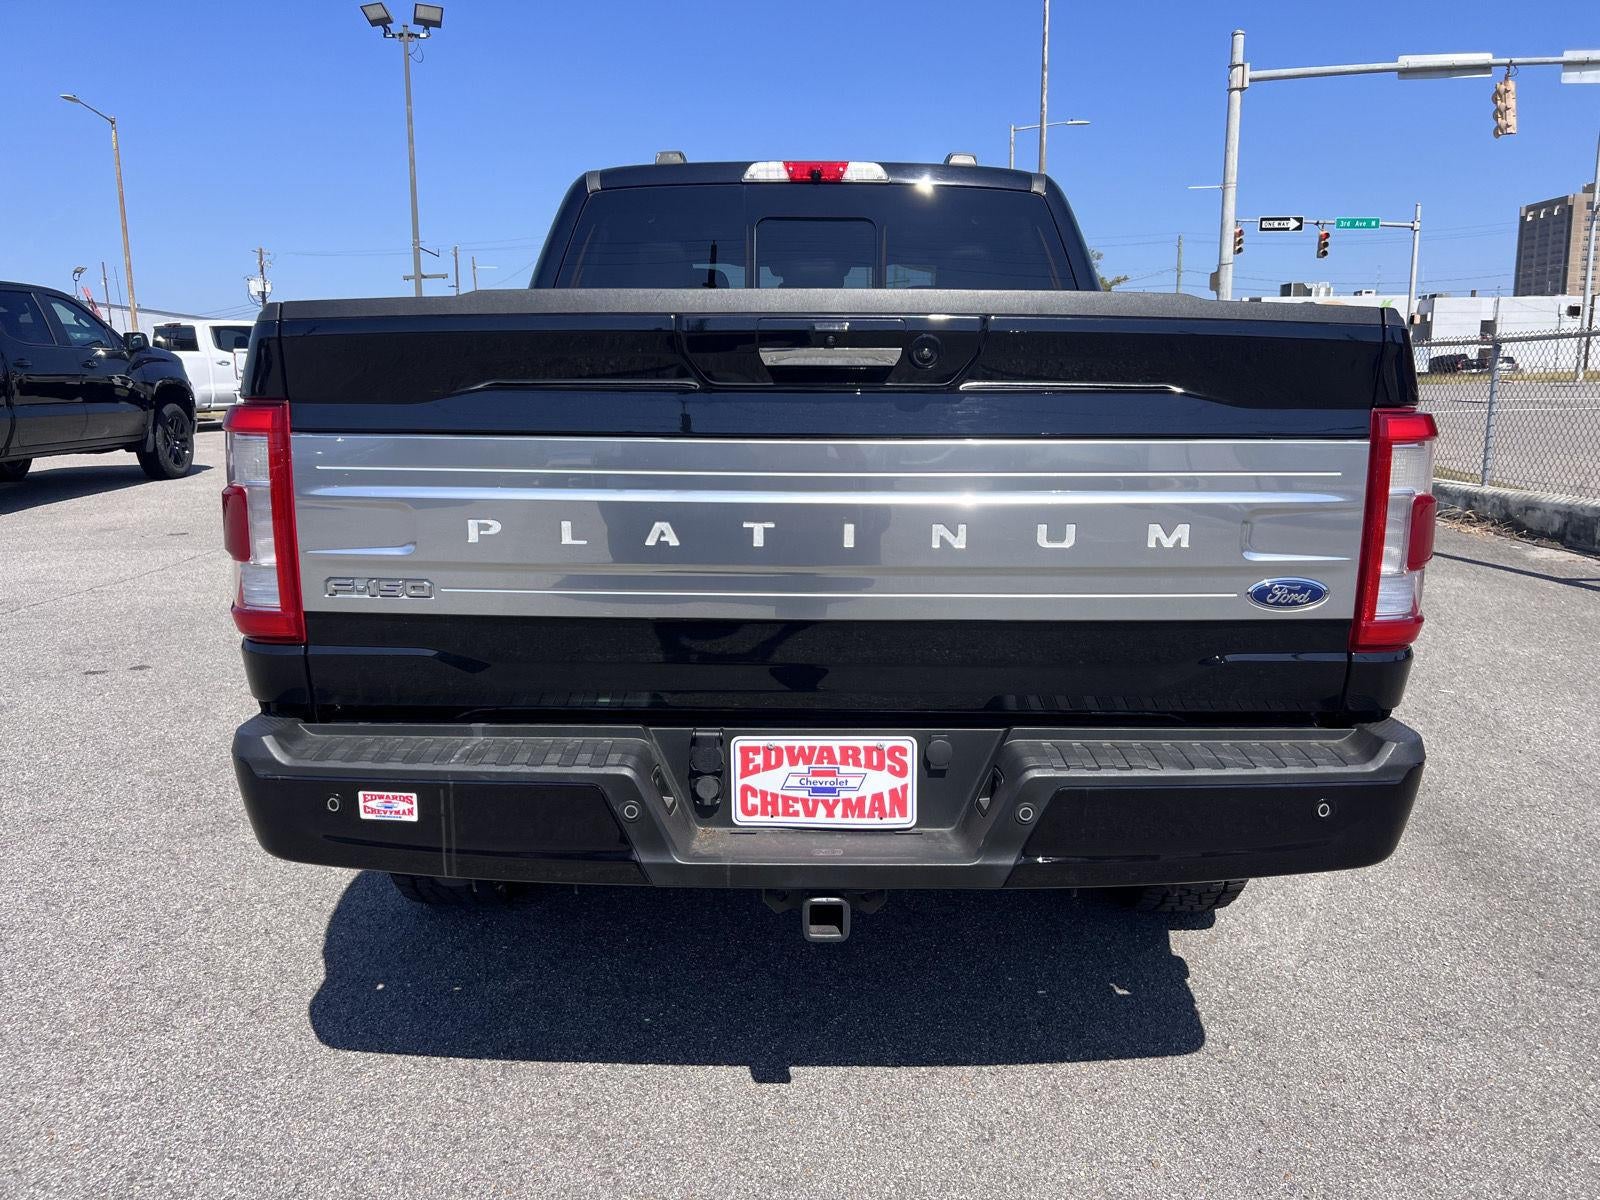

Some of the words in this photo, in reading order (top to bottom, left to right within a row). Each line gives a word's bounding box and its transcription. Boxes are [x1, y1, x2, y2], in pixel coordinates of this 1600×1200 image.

[467, 519, 1191, 549] PLATINUM
[325, 577, 434, 598] F-150
[1266, 584, 1312, 604] Ford
[739, 745, 908, 779] EDWARDS
[798, 777, 849, 787] Chevrolet
[362, 793, 414, 805] EDWARDS
[739, 783, 909, 819] CHEVYMAN
[363, 805, 414, 816] CHEVYMAN
